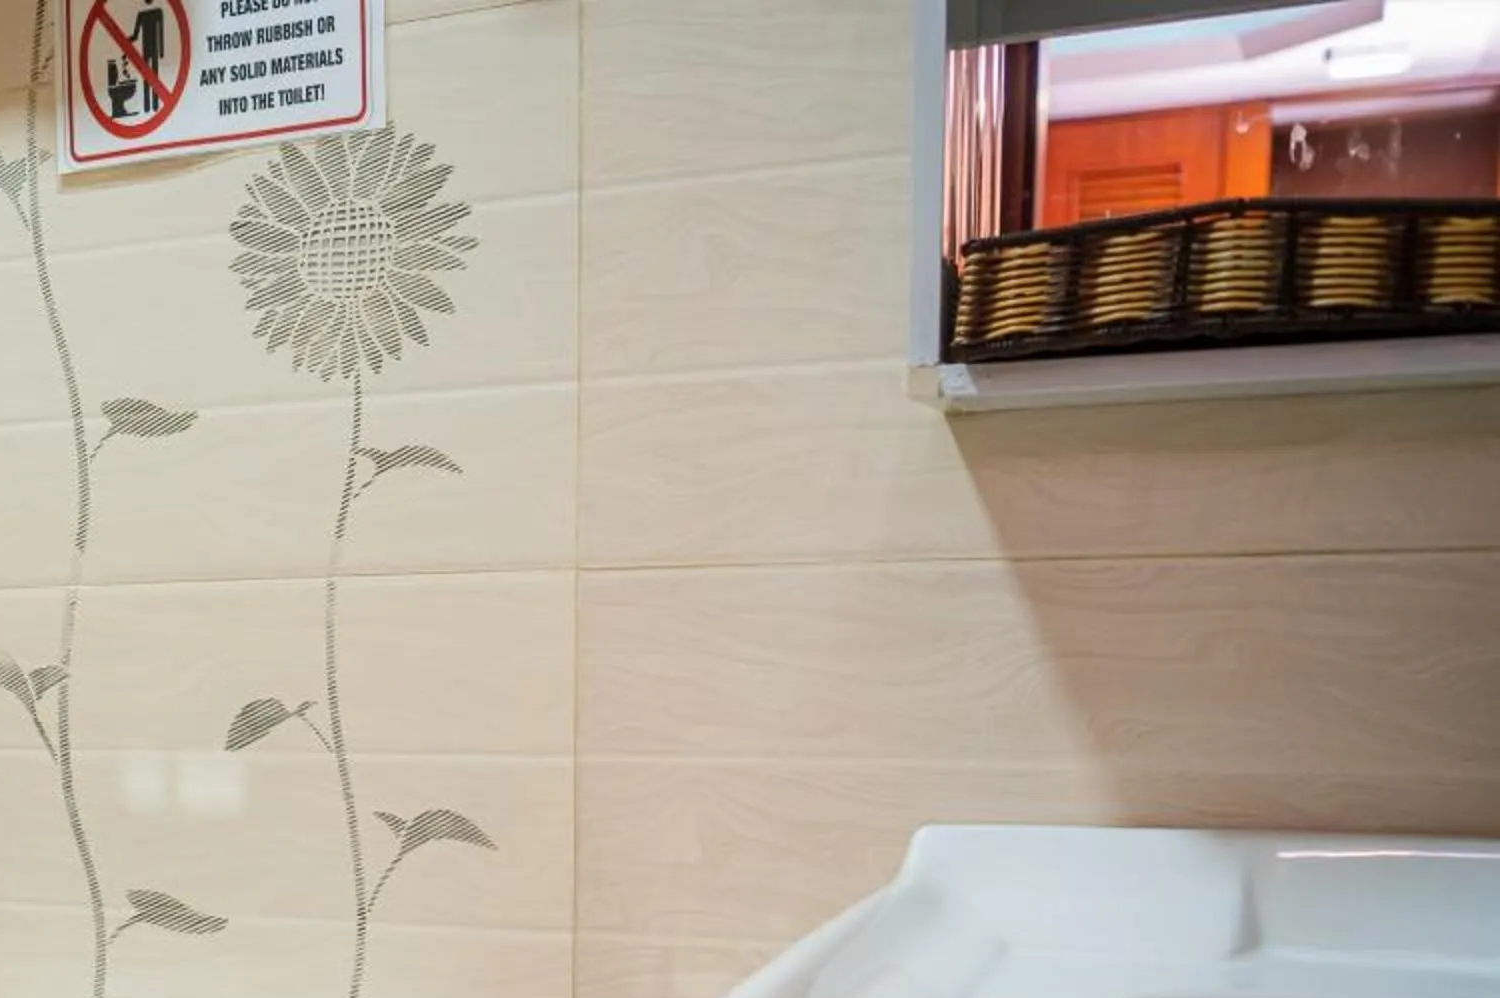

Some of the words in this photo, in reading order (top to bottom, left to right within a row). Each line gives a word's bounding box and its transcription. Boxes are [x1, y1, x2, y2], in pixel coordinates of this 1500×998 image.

[220, 0, 268, 18] PLEASE
[206, 30, 253, 52] THROW
[256, 19, 313, 45] RUBBISH
[317, 15, 335, 33] OR
[199, 67, 226, 86] ANY
[230, 60, 267, 81] SOLID
[270, 47, 344, 75] MATERIALS
[219, 97, 247, 115] INTO
[250, 92, 275, 110] THE
[277, 84, 326, 107] TOILET!
